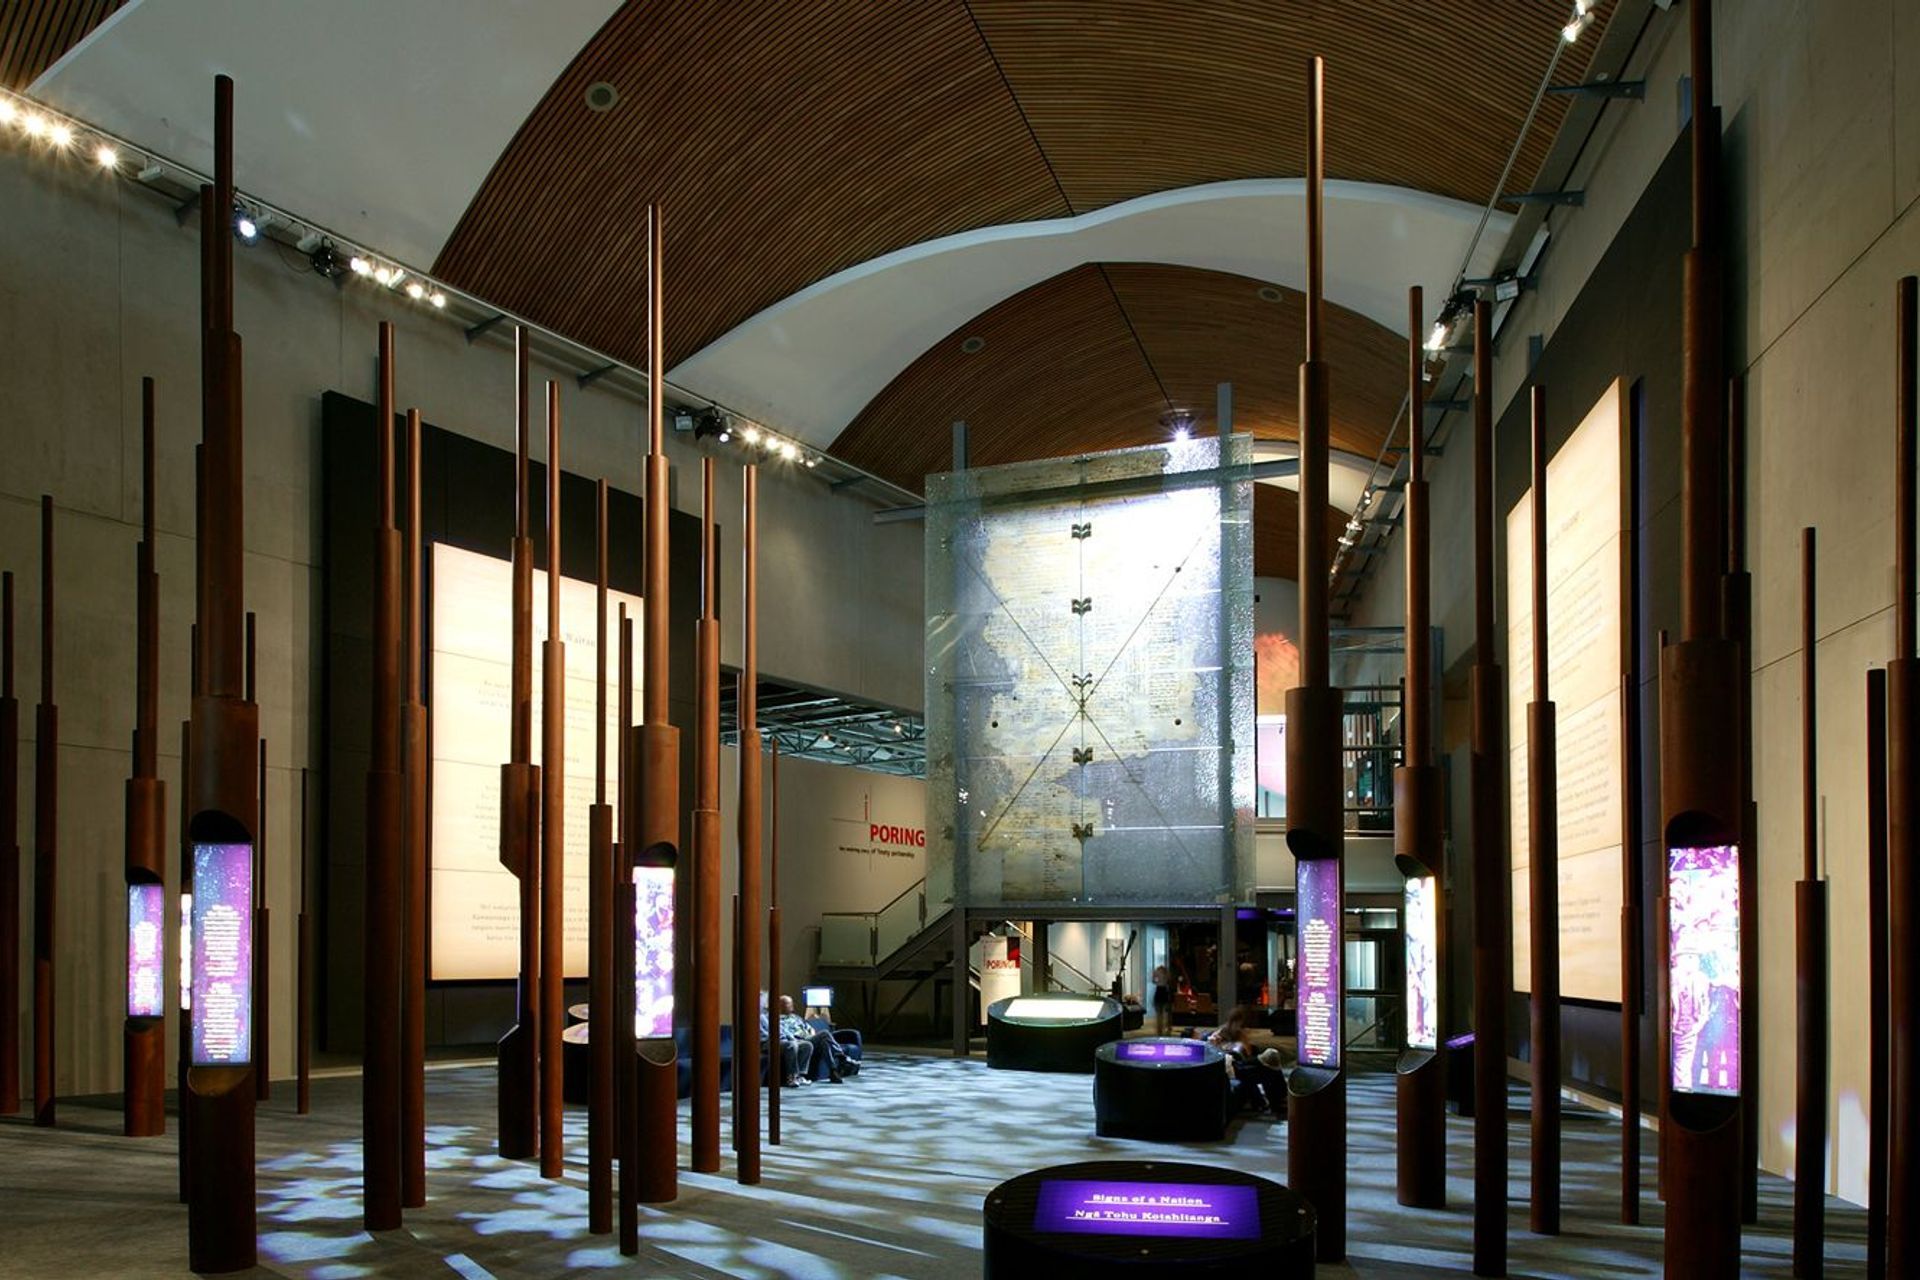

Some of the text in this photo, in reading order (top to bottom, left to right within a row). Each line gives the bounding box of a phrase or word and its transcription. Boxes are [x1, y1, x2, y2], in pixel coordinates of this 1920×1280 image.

[870, 824, 926, 847] PORING
[1092, 1193, 1128, 1203] Signs
[1131, 1194, 1146, 1203] of
[1160, 1196, 1203, 1206] Nation
[1104, 1210, 1138, 1219] Tohu
[1141, 1211, 1221, 1223] Kotahitanga
